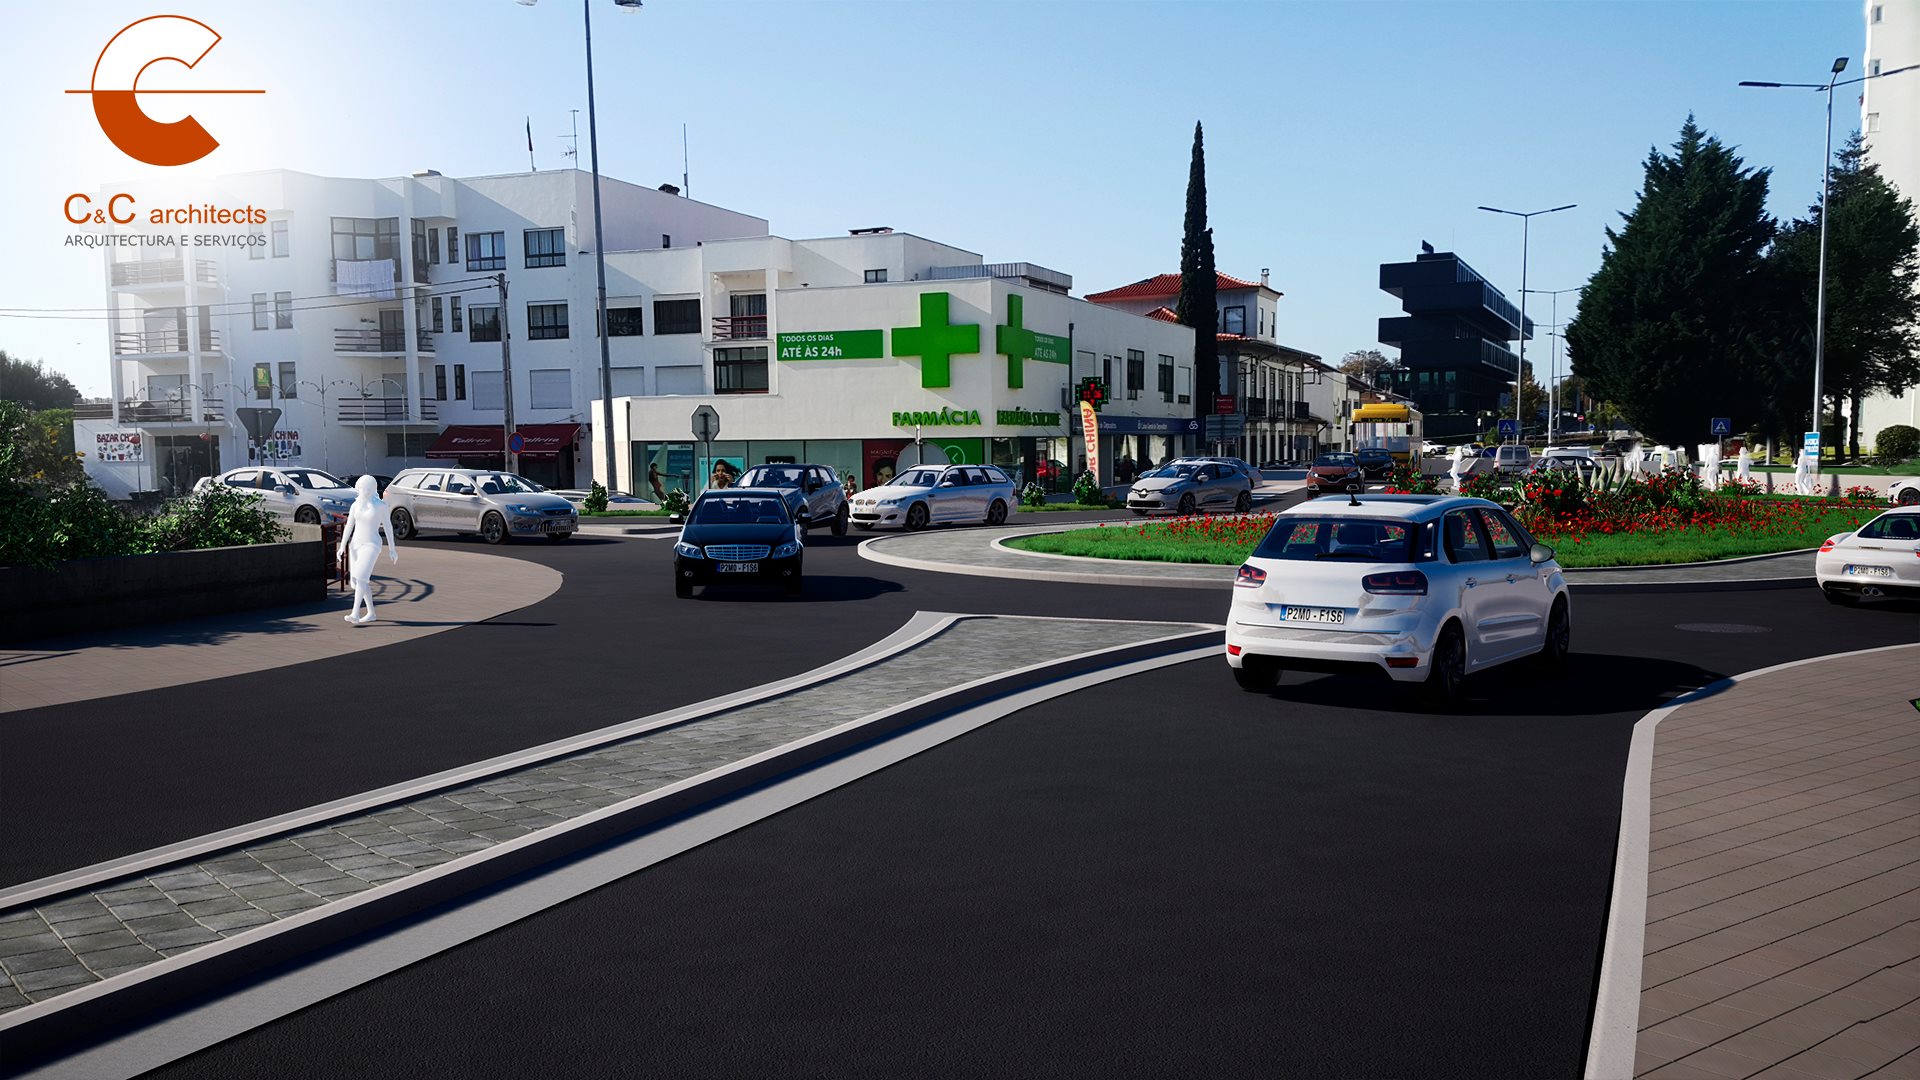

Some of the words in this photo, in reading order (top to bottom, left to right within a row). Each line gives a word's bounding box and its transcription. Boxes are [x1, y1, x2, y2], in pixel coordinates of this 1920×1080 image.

[781, 345, 802, 358] ATÉ
[804, 345, 819, 357] ÀS
[821, 346, 842, 357] 24h
[892, 406, 982, 426] FARMÁCIA
[96, 433, 119, 443] BAZAR
[1286, 608, 1310, 621] P2M0
[1319, 609, 1343, 623] F1S6
